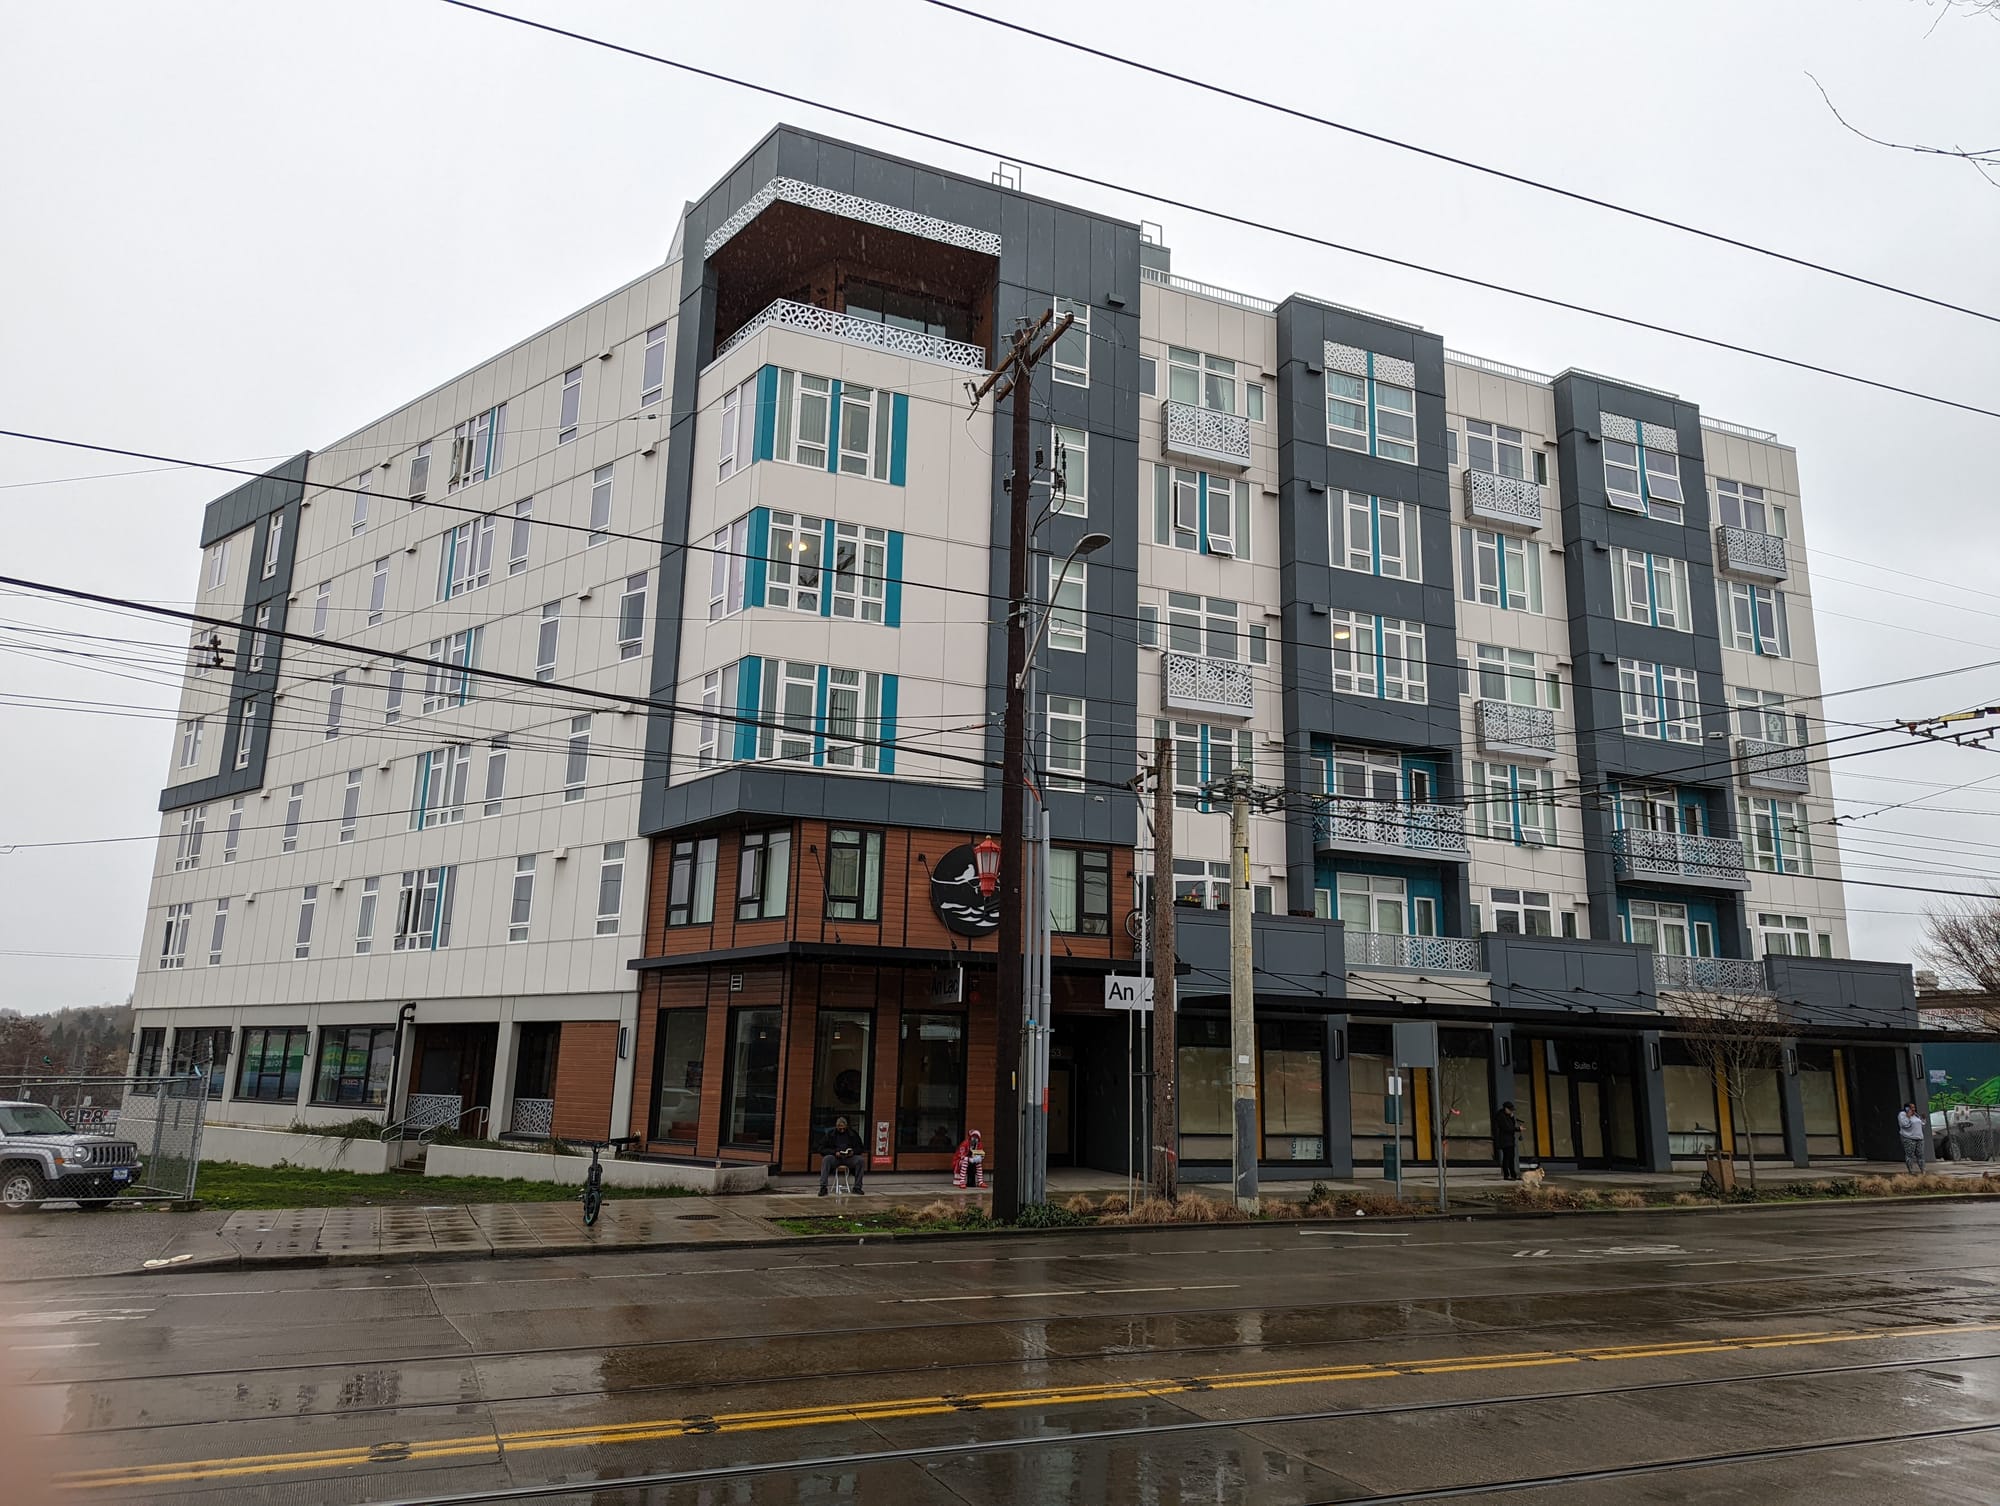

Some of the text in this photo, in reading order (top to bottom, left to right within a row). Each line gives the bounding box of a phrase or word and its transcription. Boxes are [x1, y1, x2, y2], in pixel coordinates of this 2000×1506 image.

[1108, 981, 1134, 1001] An
[1573, 1061, 1598, 1070] Suite C
